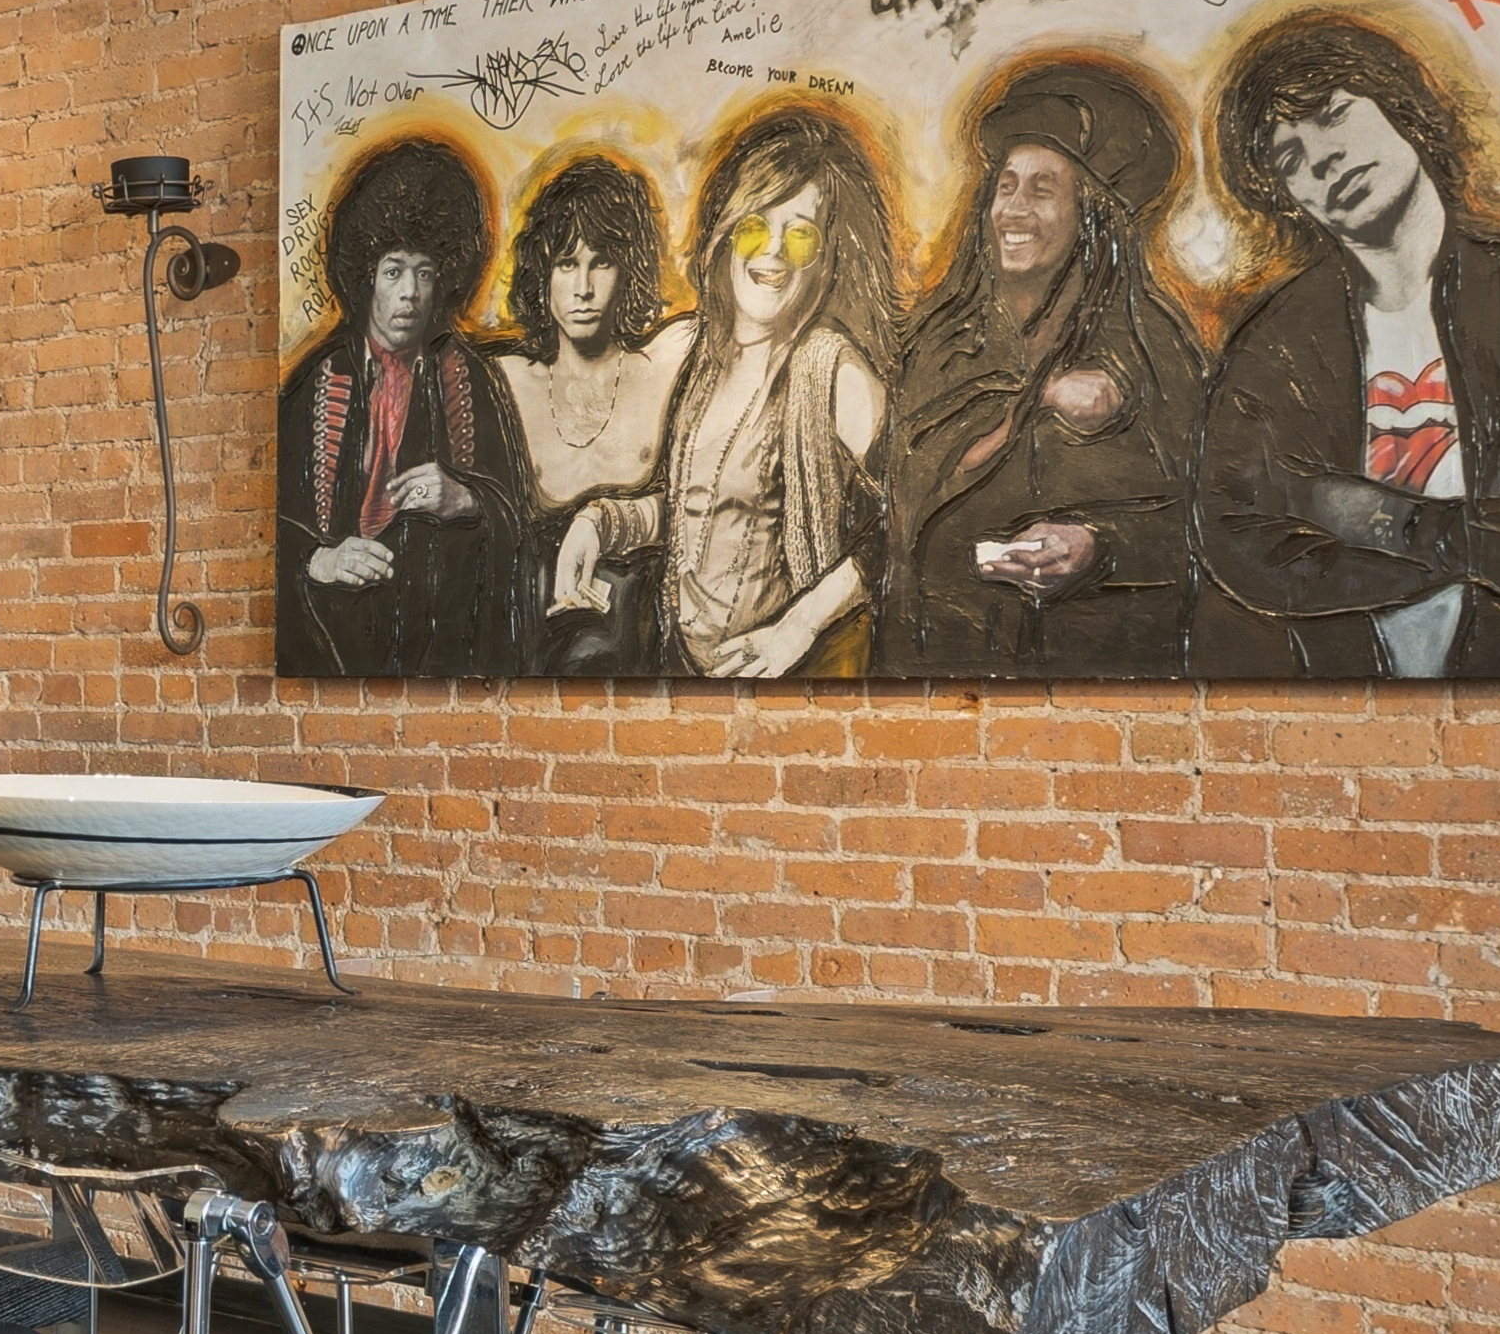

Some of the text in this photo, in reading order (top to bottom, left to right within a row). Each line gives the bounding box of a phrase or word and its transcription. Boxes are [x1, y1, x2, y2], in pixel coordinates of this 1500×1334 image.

[347, 17, 388, 46] UPON
[398, 13, 410, 35] A
[421, 4, 458, 30] TYME
[594, 23, 628, 57] Live
[634, 3, 653, 27] the
[721, 12, 783, 44] Amelie
[594, 54, 633, 94] Love
[636, 37, 656, 57] the
[657, 22, 680, 49] life
[683, 16, 708, 45] you
[345, 75, 378, 107] Not
[767, 67, 797, 83] YOUR
[808, 75, 854, 95] DREAM
[285, 193, 318, 226] SEX
[290, 238, 328, 283] ROCK
